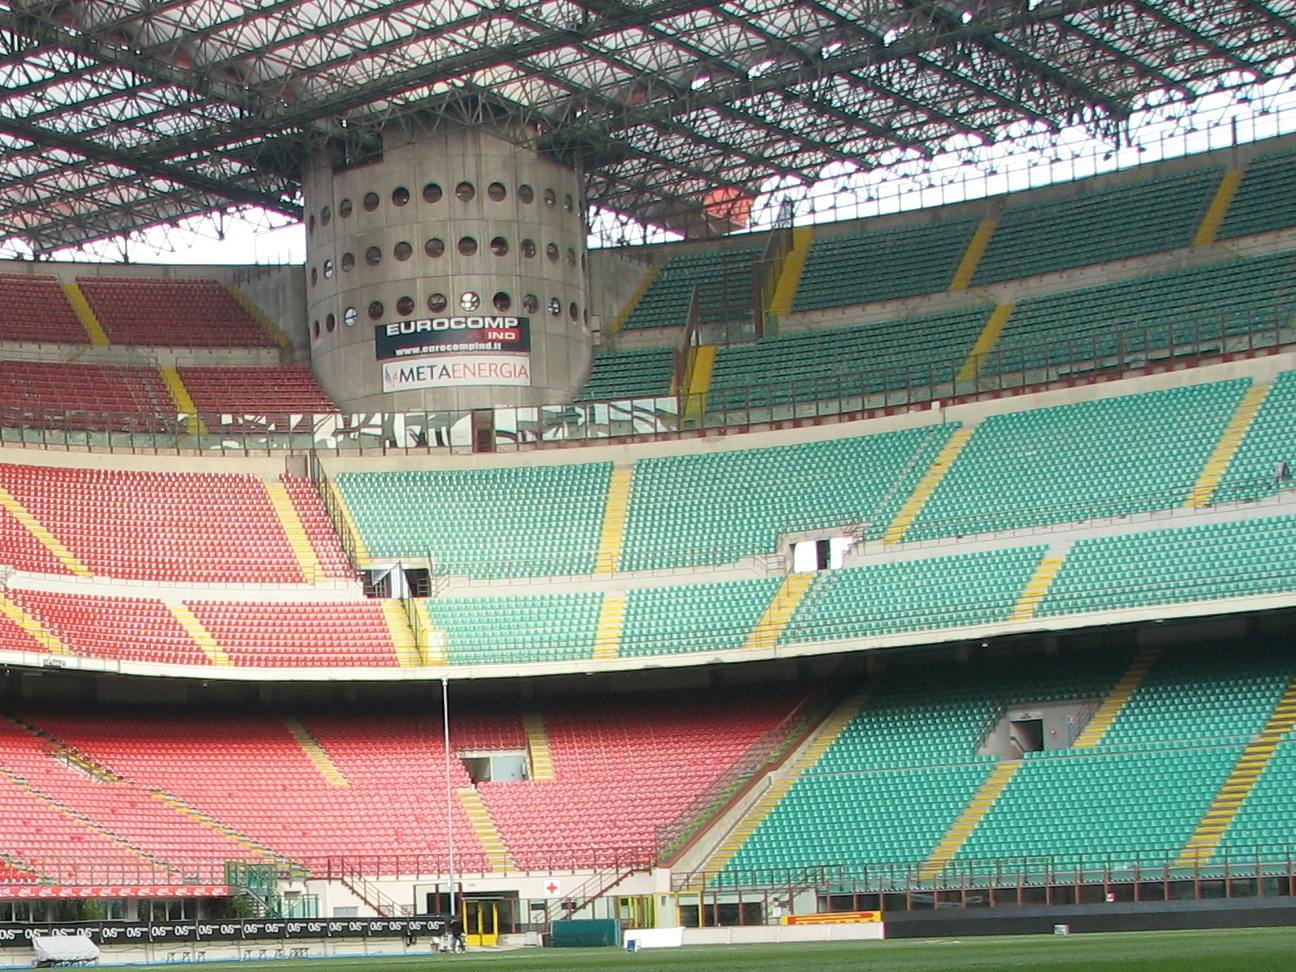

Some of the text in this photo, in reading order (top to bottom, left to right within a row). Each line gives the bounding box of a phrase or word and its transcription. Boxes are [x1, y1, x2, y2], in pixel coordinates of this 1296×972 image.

[386, 317, 518, 336] EUROCOMP
[487, 331, 516, 340] IND
[399, 362, 530, 384] METAENERGIA
